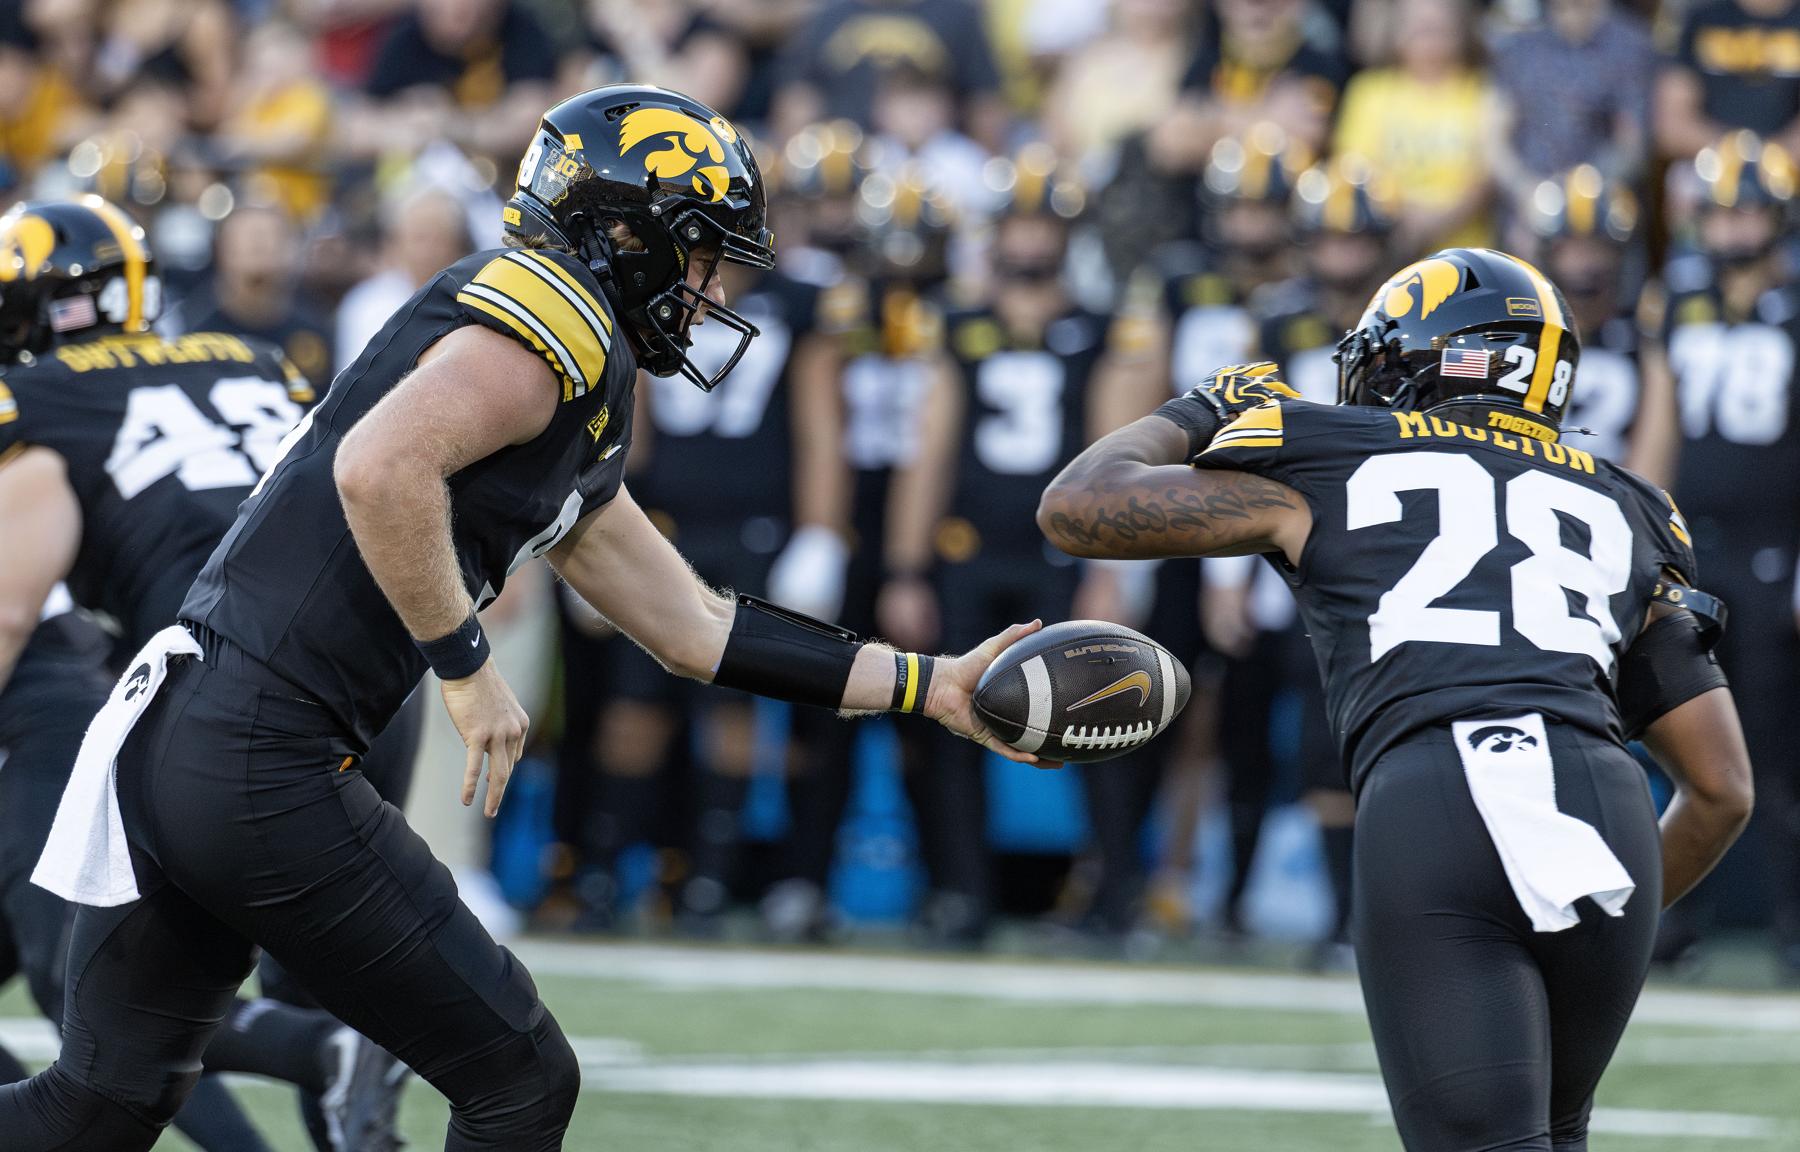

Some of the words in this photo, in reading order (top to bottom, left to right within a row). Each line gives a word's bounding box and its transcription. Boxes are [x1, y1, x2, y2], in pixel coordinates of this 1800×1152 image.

[971, 350, 1066, 476] 3
[1496, 344, 1572, 407] 28
[1667, 322, 1793, 446] 78
[1345, 450, 1634, 680] 28
